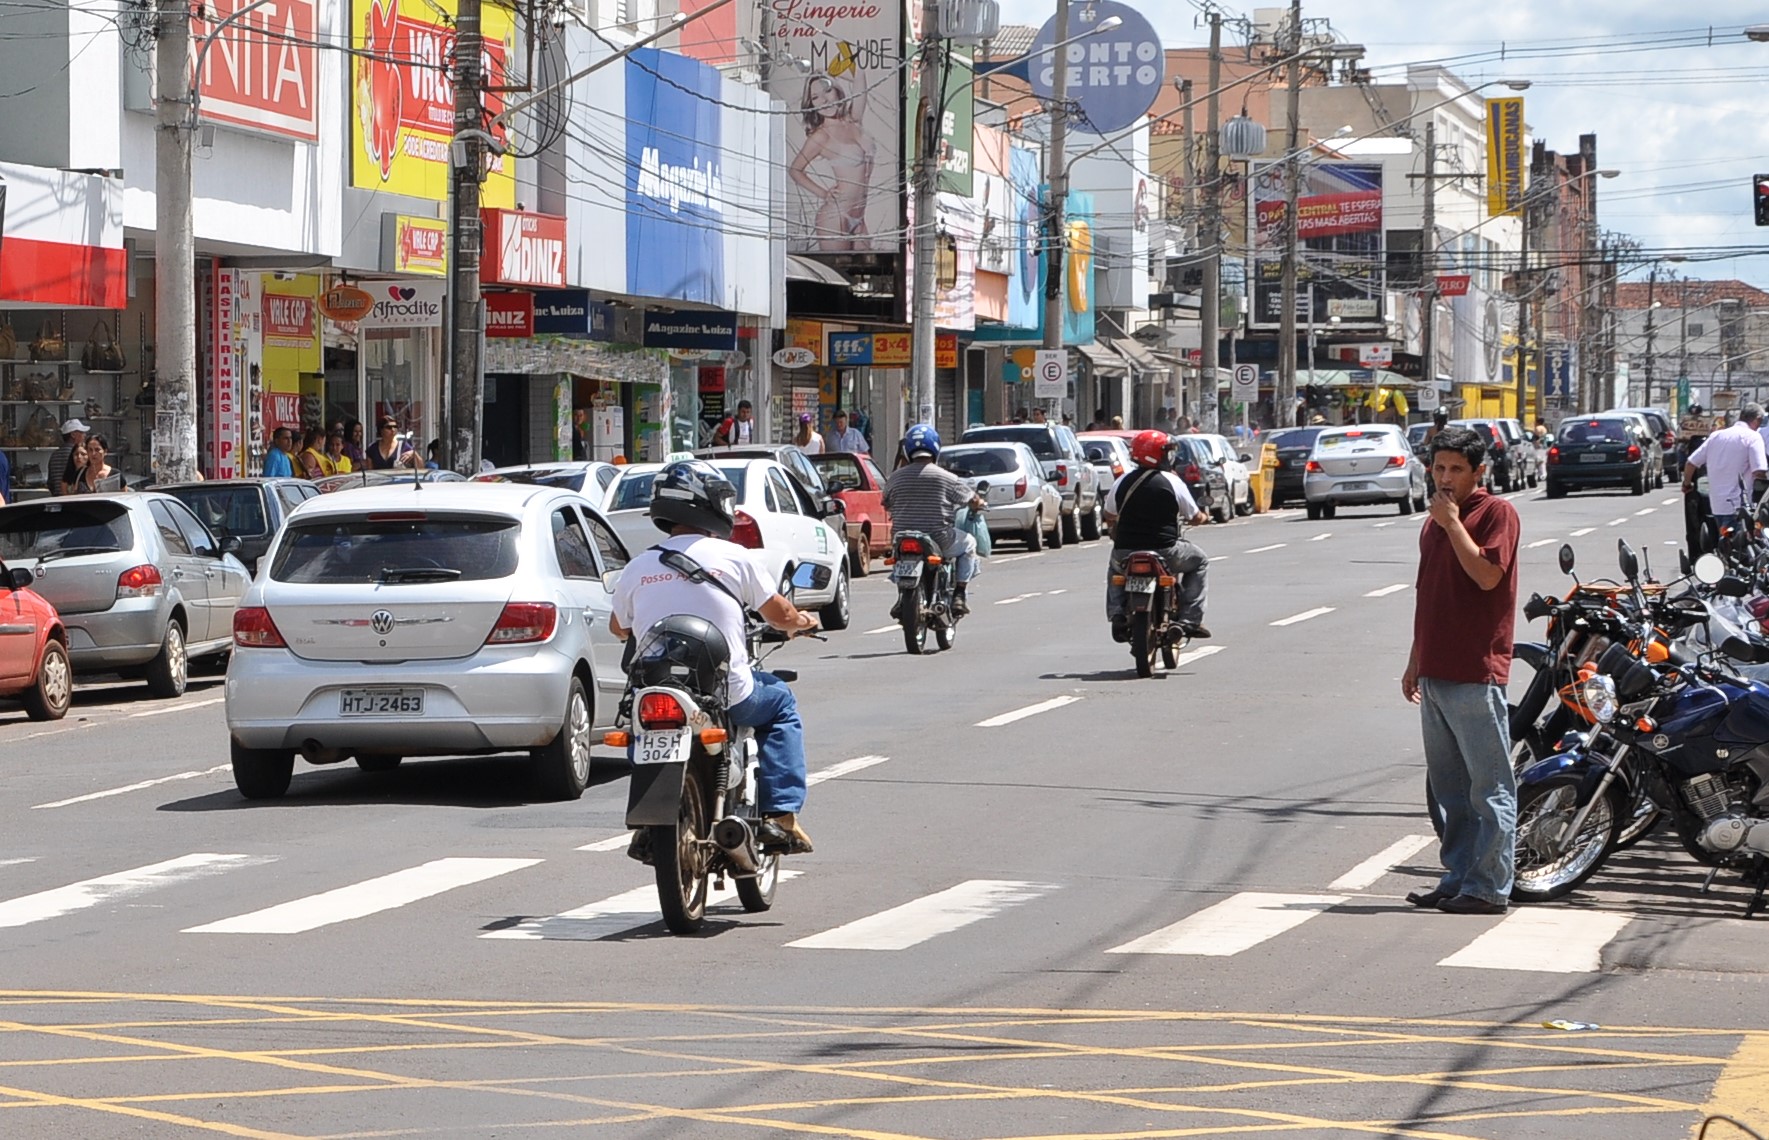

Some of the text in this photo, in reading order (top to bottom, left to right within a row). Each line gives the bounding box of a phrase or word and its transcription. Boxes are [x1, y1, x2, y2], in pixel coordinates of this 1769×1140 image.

[772, 0, 881, 27] Lingerie
[777, 23, 818, 38] é na
[1042, 41, 1157, 63] PONTO
[1040, 65, 1157, 87] CERTO
[1340, 201, 1351, 213] TE
[412, 229, 438, 251] VALE CAP
[521, 237, 562, 285] DINIZ
[1439, 280, 1465, 290] ZERO
[270, 298, 289, 326] VALE
[290, 300, 306, 326] CAP
[373, 301, 439, 319] Afrodite
[549, 305, 585, 316] Luiza
[648, 322, 733, 335] Magazine Luiza
[220, 274, 231, 413] RASTEIRINHAS
[1047, 366, 1056, 377] E
[1241, 369, 1250, 381] E
[275, 395, 294, 421] VALE
[643, 735, 681, 749] HSH
[642, 749, 679, 761] 3041
